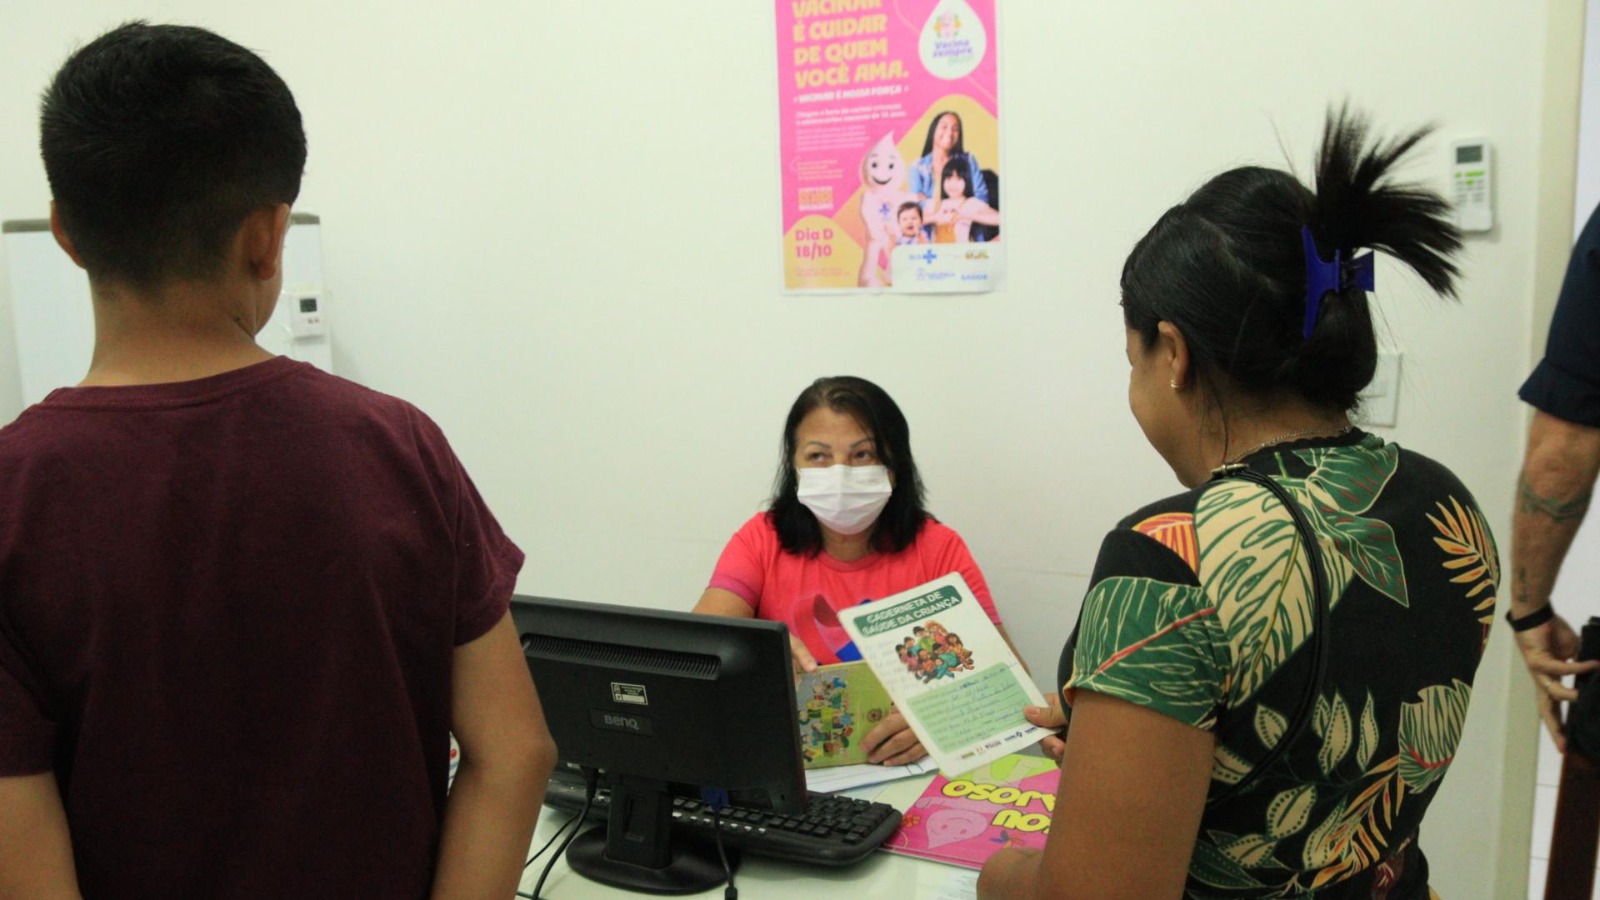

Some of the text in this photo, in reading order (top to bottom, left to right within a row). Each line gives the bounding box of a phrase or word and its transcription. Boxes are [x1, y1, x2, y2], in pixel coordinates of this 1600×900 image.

[792, 0, 883, 18] VACINAR
[793, 14, 888, 42] É CUIDAR
[794, 37, 888, 66] DE QUEM
[795, 60, 909, 89] VOCÊ AMA.
[795, 227, 833, 241] Dia D
[796, 242, 832, 260] 18/10
[862, 596, 959, 635] SAÚDE DA CRIANÇA
[867, 590, 944, 623] CADERNETA DE
[603, 714, 640, 731] BenQ
